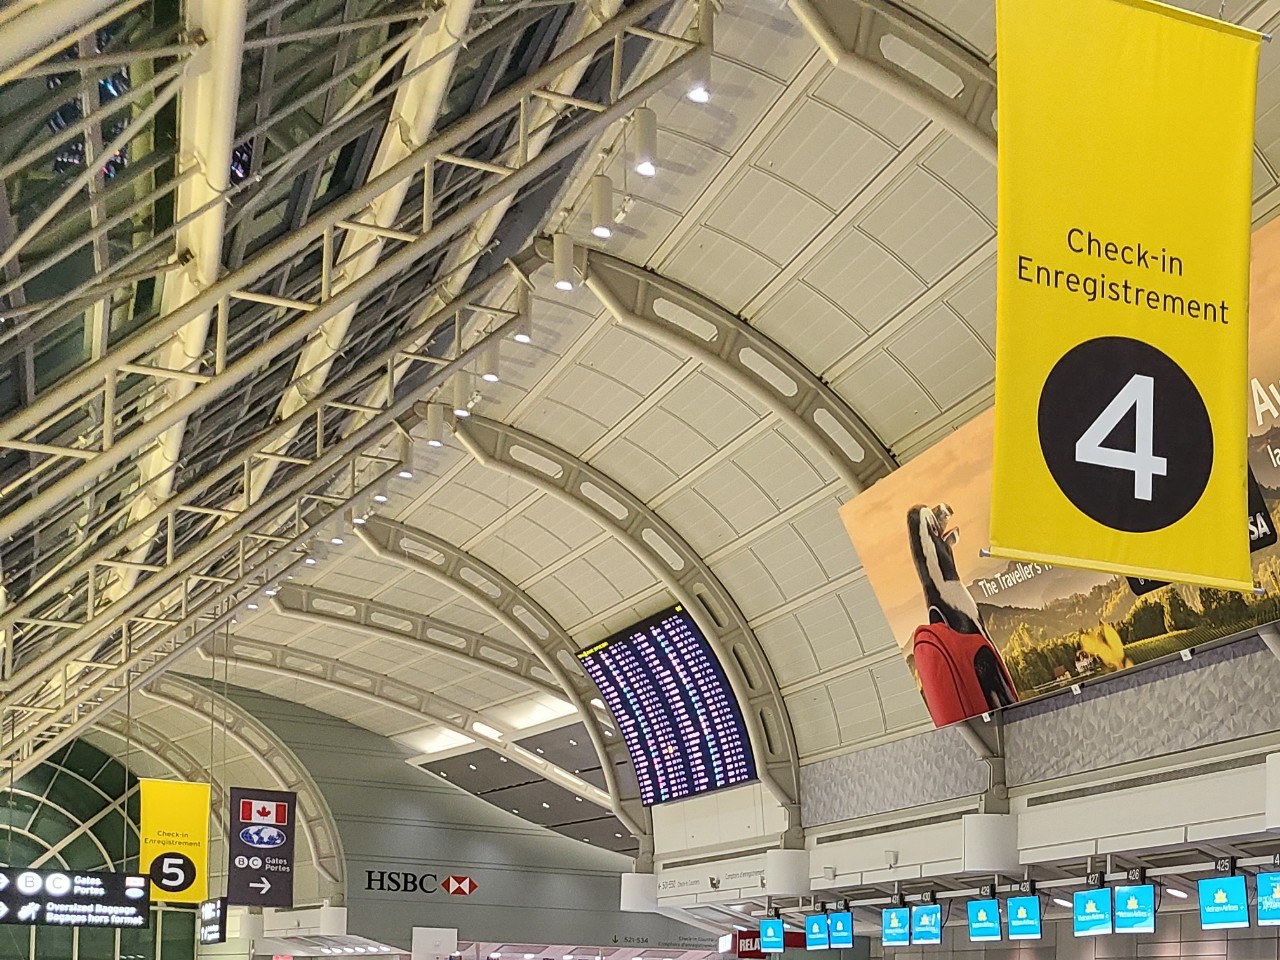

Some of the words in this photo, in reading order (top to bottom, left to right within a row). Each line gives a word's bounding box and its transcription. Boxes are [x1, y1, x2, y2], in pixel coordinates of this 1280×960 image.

[1066, 228, 1184, 277] Check-in
[1018, 255, 1229, 324] Enregistrement
[1074, 373, 1168, 502] 4
[978, 579, 999, 598] The
[994, 562, 1042, 591] Traveller's
[157, 830, 189, 839] Check-in
[144, 837, 201, 848] Enregistrement
[264, 856, 287, 866] Gates
[1216, 859, 1230, 871] 425
[161, 857, 185, 887] 5
[264, 864, 291, 873] Portes
[1128, 868, 1140, 880] 426
[73, 874, 103, 886] Gates
[364, 870, 438, 894] HSBC
[1087, 873, 1099, 885] 427
[73, 885, 106, 896] Portes
[980, 886, 990, 896] 429
[1020, 881, 1030, 892] 428
[921, 891, 931, 901] 430
[46, 901, 94, 914] Oversized
[95, 902, 138, 915] Baggage
[45, 912, 87, 925] Bagages
[87, 913, 110, 925] hors
[109, 914, 145, 926] format
[739, 938, 761, 952] RELA
